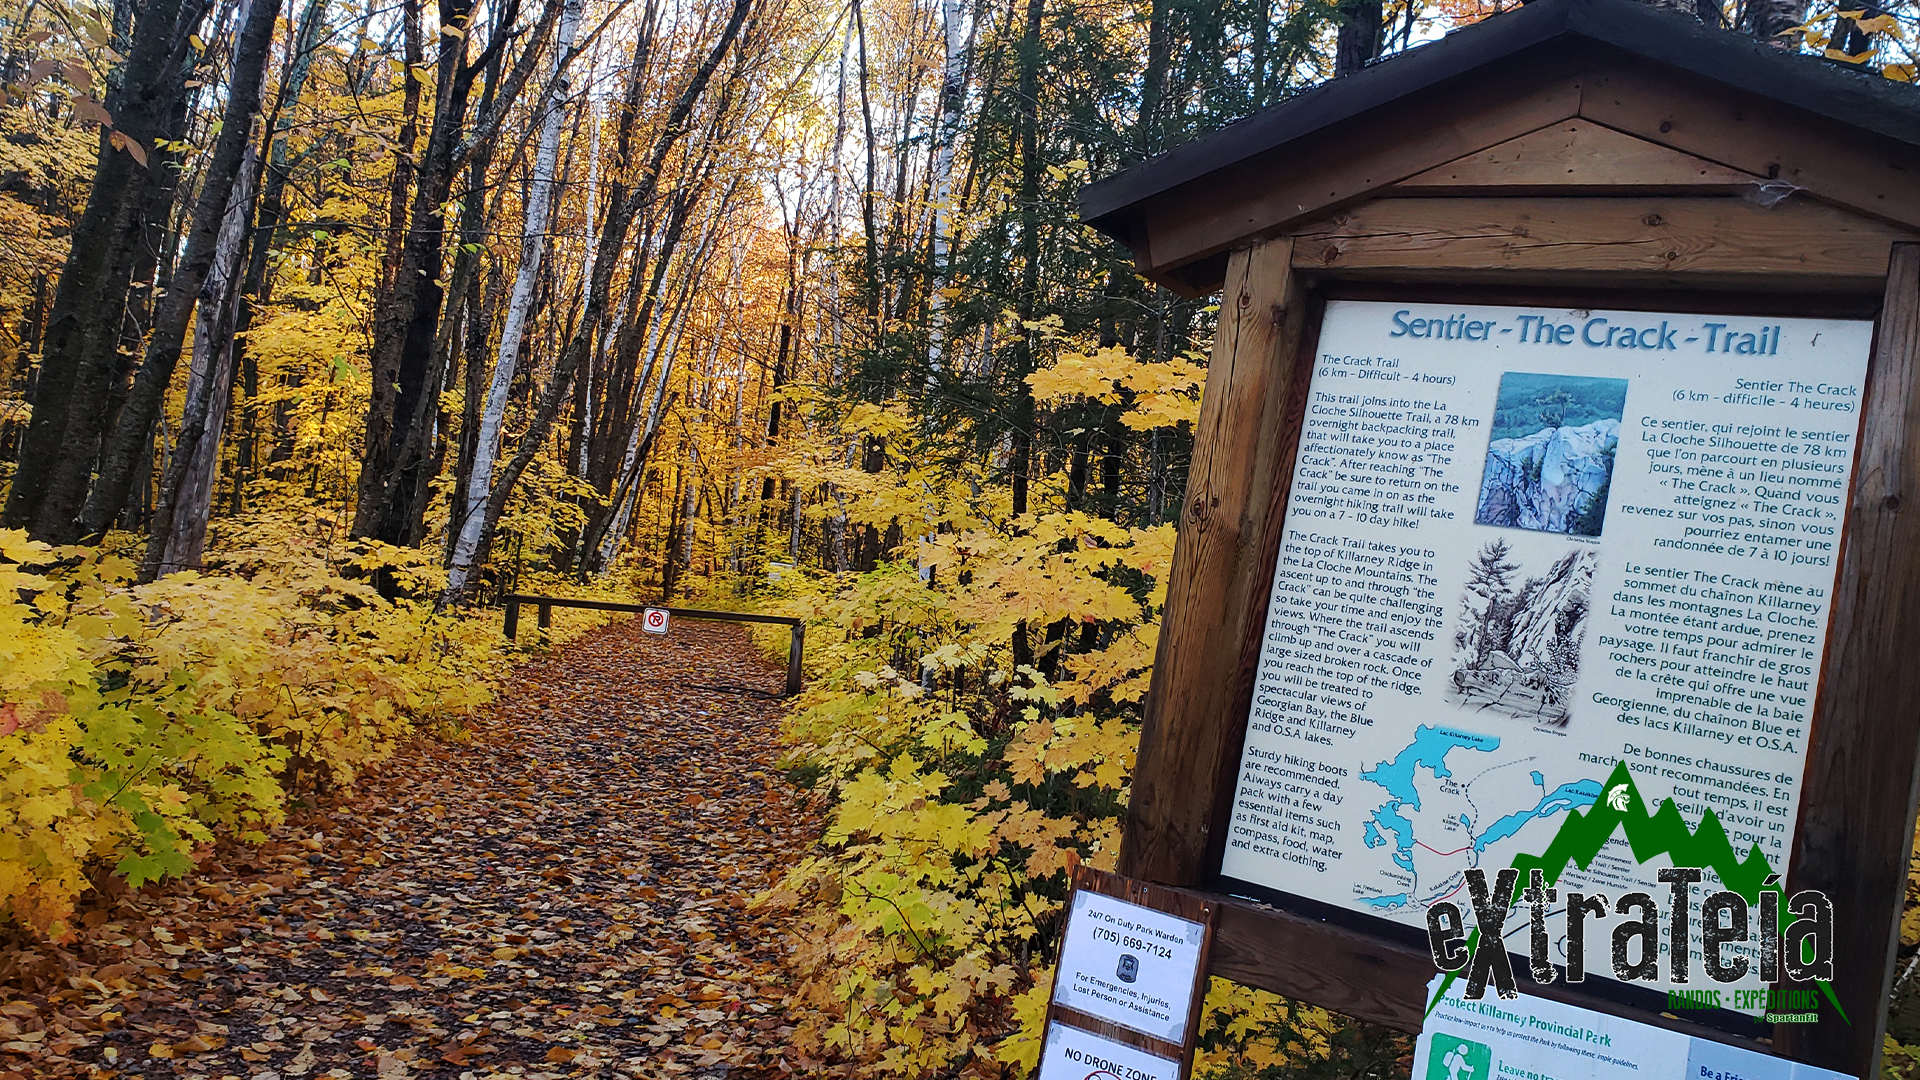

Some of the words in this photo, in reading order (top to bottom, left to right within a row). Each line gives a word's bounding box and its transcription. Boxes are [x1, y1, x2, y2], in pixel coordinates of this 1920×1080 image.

[1389, 310, 1497, 341] Sentier
[1514, 314, 1575, 346] The
[1582, 317, 1678, 351] Crack
[1700, 322, 1782, 356] Trail
[1322, 354, 1340, 364] The
[1343, 355, 1371, 366] Crack
[1376, 357, 1399, 367] Trail
[1734, 378, 1784, 391] Sentier
[1788, 381, 1813, 394] The
[1817, 383, 1857, 397] Crack
[1309, 419, 1358, 432] overnight
[1361, 421, 1428, 438] backpacking
[1432, 428, 1455, 439] trail,
[1311, 404, 1346, 416] Cloche
[1348, 407, 1402, 420] Silhouette
[1406, 411, 1431, 423] Trail,
[1445, 414, 1458, 425] 78
[1461, 416, 1479, 426] km
[1304, 443, 1376, 460] affectionately
[1378, 449, 1408, 460] know
[1411, 454, 1423, 464] as
[1427, 453, 1451, 465] “The
[1642, 431, 1656, 442] La
[1660, 432, 1704, 446] Cloche
[1708, 436, 1777, 452] Silhouette
[1781, 442, 1798, 454] de
[1804, 444, 1820, 455] 78
[1825, 445, 1846, 457] km
[1646, 449, 1670, 459] que
[1675, 448, 1696, 460] l’on
[1700, 453, 1757, 466] parcourt
[1760, 459, 1777, 467] en
[1781, 458, 1844, 473] plusieurs
[1684, 527, 1739, 540] pourriez
[1744, 533, 1802, 547] entamer
[1806, 540, 1831, 550] une
[1285, 543, 1301, 553] the
[1304, 546, 1321, 558] top
[1323, 548, 1335, 558] of
[1337, 549, 1384, 567] Killarney
[1387, 556, 1420, 571] Ridge
[1423, 561, 1432, 571] in
[1278, 580, 1311, 593] Crack”
[1312, 588, 1330, 597] can
[1333, 589, 1346, 599] be
[1349, 593, 1376, 604] quite
[1379, 596, 1443, 617] challenging
[1623, 579, 1676, 594] sommet
[1680, 584, 1696, 596] du
[1700, 587, 1753, 603] chaînon
[1758, 594, 1821, 615] Killarney
[1257, 695, 1302, 712] Georgian
[1305, 704, 1327, 718] Bay,
[1330, 709, 1347, 721] the
[1350, 713, 1373, 726] Blue
[1259, 684, 1317, 701] spectacular
[1320, 695, 1351, 708] views
[1354, 701, 1367, 711] of
[1616, 712, 1640, 725] des
[1644, 716, 1668, 730] lacs
[1673, 721, 1734, 744] Killarney
[1737, 735, 1752, 745] et
[1756, 736, 1797, 753] O.S.A.
[1245, 761, 1261, 770] are
[1263, 765, 1339, 789] recommended.
[1248, 746, 1281, 763] Sturdy
[1284, 753, 1316, 772] hiking
[1318, 761, 1347, 776] boots
[1623, 743, 1640, 756] De
[1645, 747, 1691, 765] bonnes
[1695, 758, 1770, 781] chaussures
[1774, 772, 1792, 785] de
[1439, 785, 1460, 796] Crack
[1445, 778, 1458, 788] The
[1231, 839, 1250, 850] and
[1253, 844, 1279, 858] extra
[1282, 851, 1327, 872] clothing.
[1088, 909, 1104, 920] 24/7
[1104, 914, 1116, 924] On
[1117, 918, 1135, 931] Duty
[1135, 923, 1153, 936] Park
[1155, 929, 1184, 945] Warden
[1093, 926, 1120, 946] (705)
[1123, 935, 1172, 960] 669-7124
[1075, 971, 1089, 982] For
[1073, 983, 1090, 995] Lost
[1090, 989, 1117, 1004] Person
[1118, 999, 1128, 1007] or
[1128, 1001, 1170, 1022] Assistance
[1478, 1002, 1527, 1028] Killarney
[1529, 1015, 1584, 1040] Provincial
[1585, 1029, 1612, 1048] Park
[1065, 1047, 1082, 1062] NO
[1084, 1054, 1124, 1076] DRONE
[1499, 1060, 1525, 1078] Leave
[1527, 1071, 1538, 1080] no
[1701, 1066, 1713, 1078] Be
[1716, 1072, 1722, 1080] a
